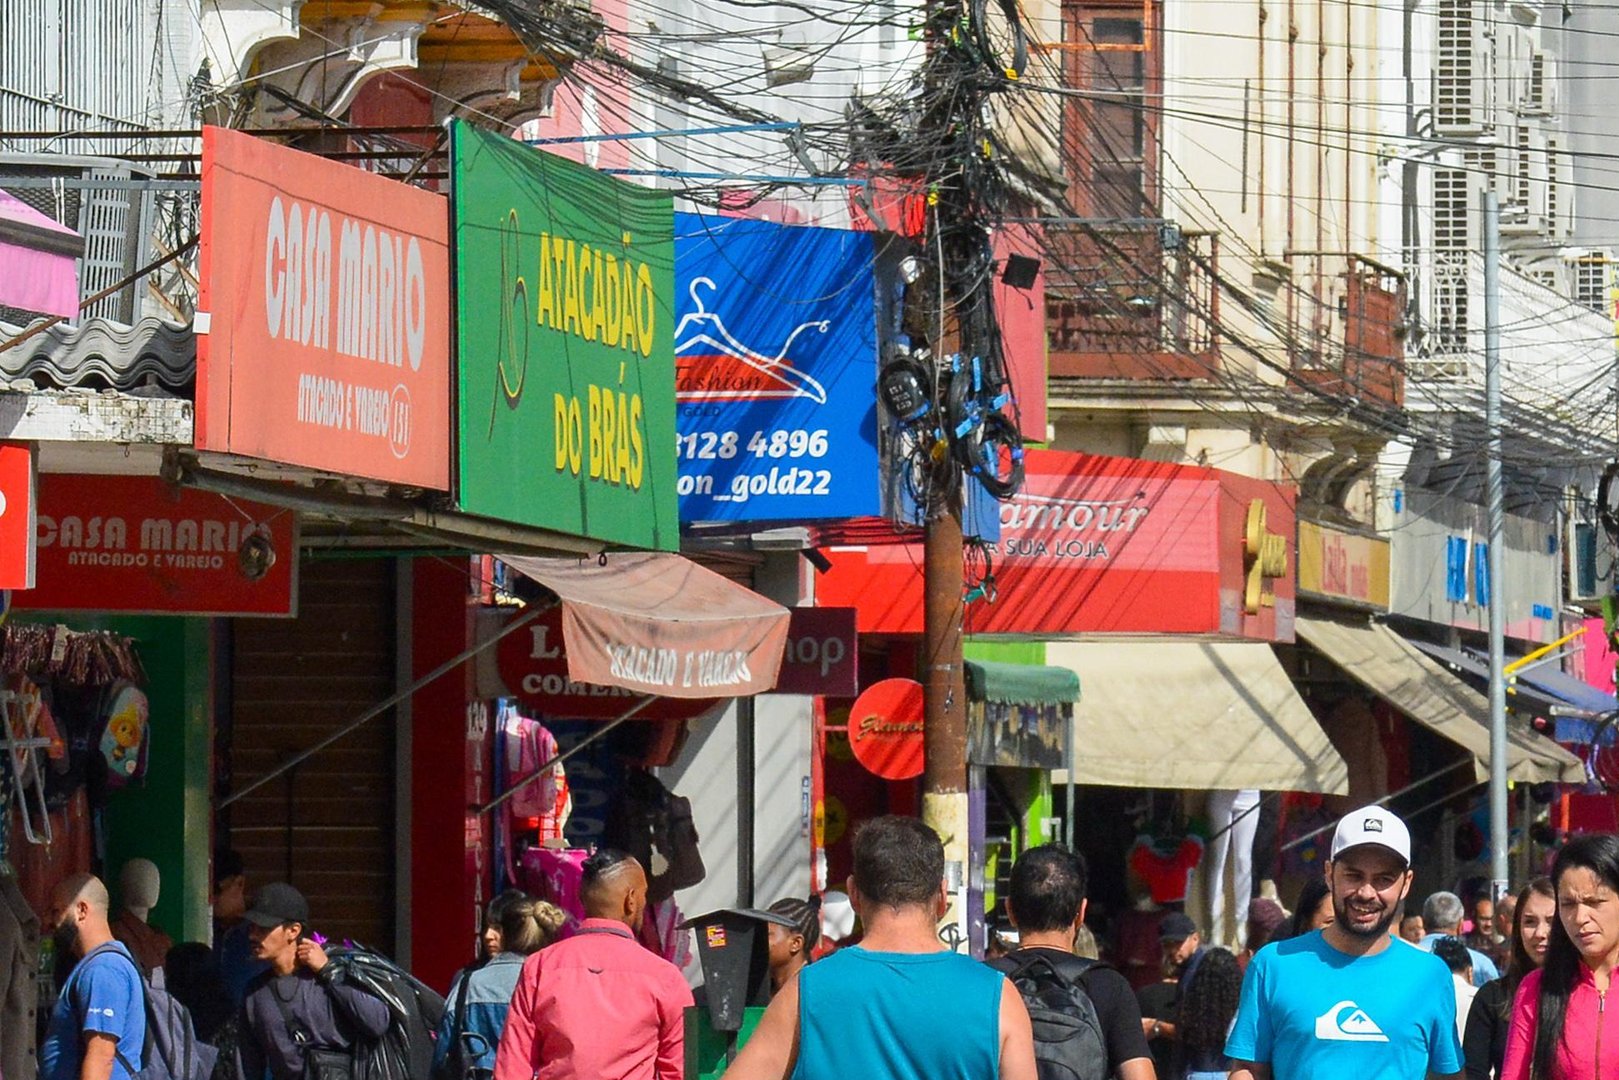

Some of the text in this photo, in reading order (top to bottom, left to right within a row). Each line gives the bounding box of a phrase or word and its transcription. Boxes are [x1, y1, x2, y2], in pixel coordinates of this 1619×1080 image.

[265, 195, 426, 373] CASA MARIO
[537, 230, 655, 358] ATACADÃO
[297, 373, 390, 437] ATACADO E VAREJO
[554, 361, 645, 490] DO BRÁS
[746, 429, 828, 459] 4896
[36, 515, 127, 548] CASA
[1006, 539, 1048, 557] SUA
[1056, 541, 1109, 560] LOJA
[68, 551, 223, 569] ATACADO E VAREJO
[682, 650, 693, 688] E
